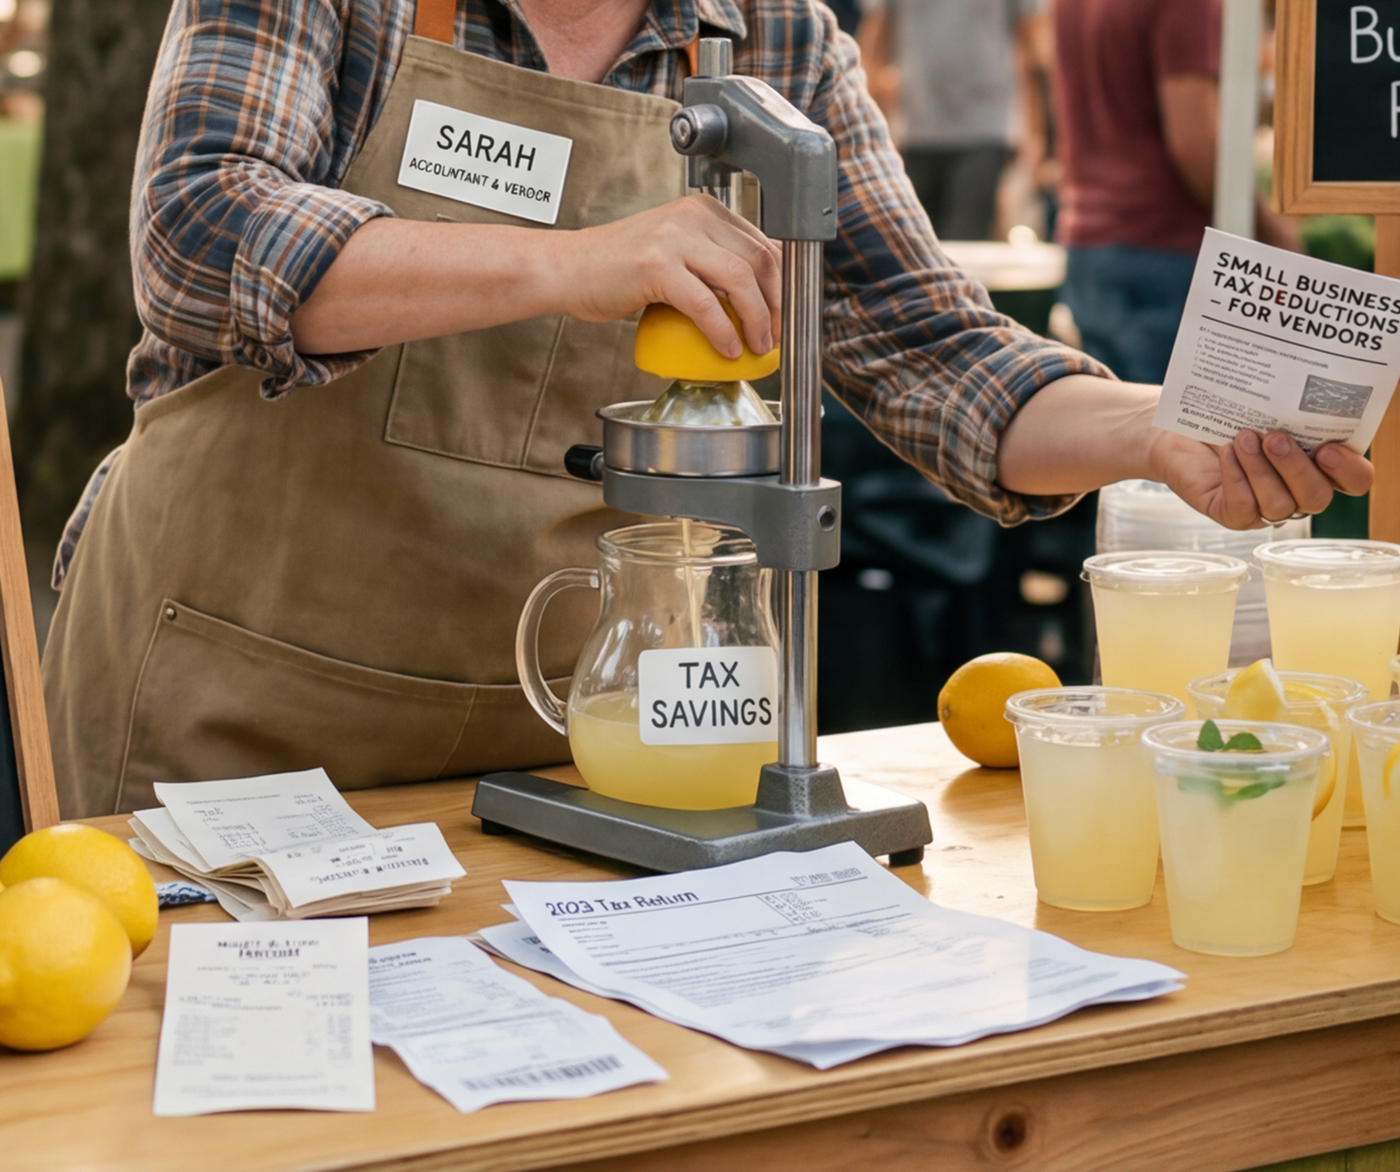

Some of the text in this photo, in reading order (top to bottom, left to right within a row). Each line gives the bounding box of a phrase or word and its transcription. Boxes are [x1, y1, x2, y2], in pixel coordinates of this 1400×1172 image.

[436, 125, 536, 172] SARAH
[409, 157, 489, 187] ACCOUNTANT
[1217, 252, 1288, 287] SMALL
[1213, 270, 1400, 334] TAX DEDUCTIONS
[1228, 297, 1271, 323] FOR
[1279, 311, 1383, 351] VENDORS
[678, 661, 740, 689] TAX
[651, 696, 772, 729] SAVINGS
